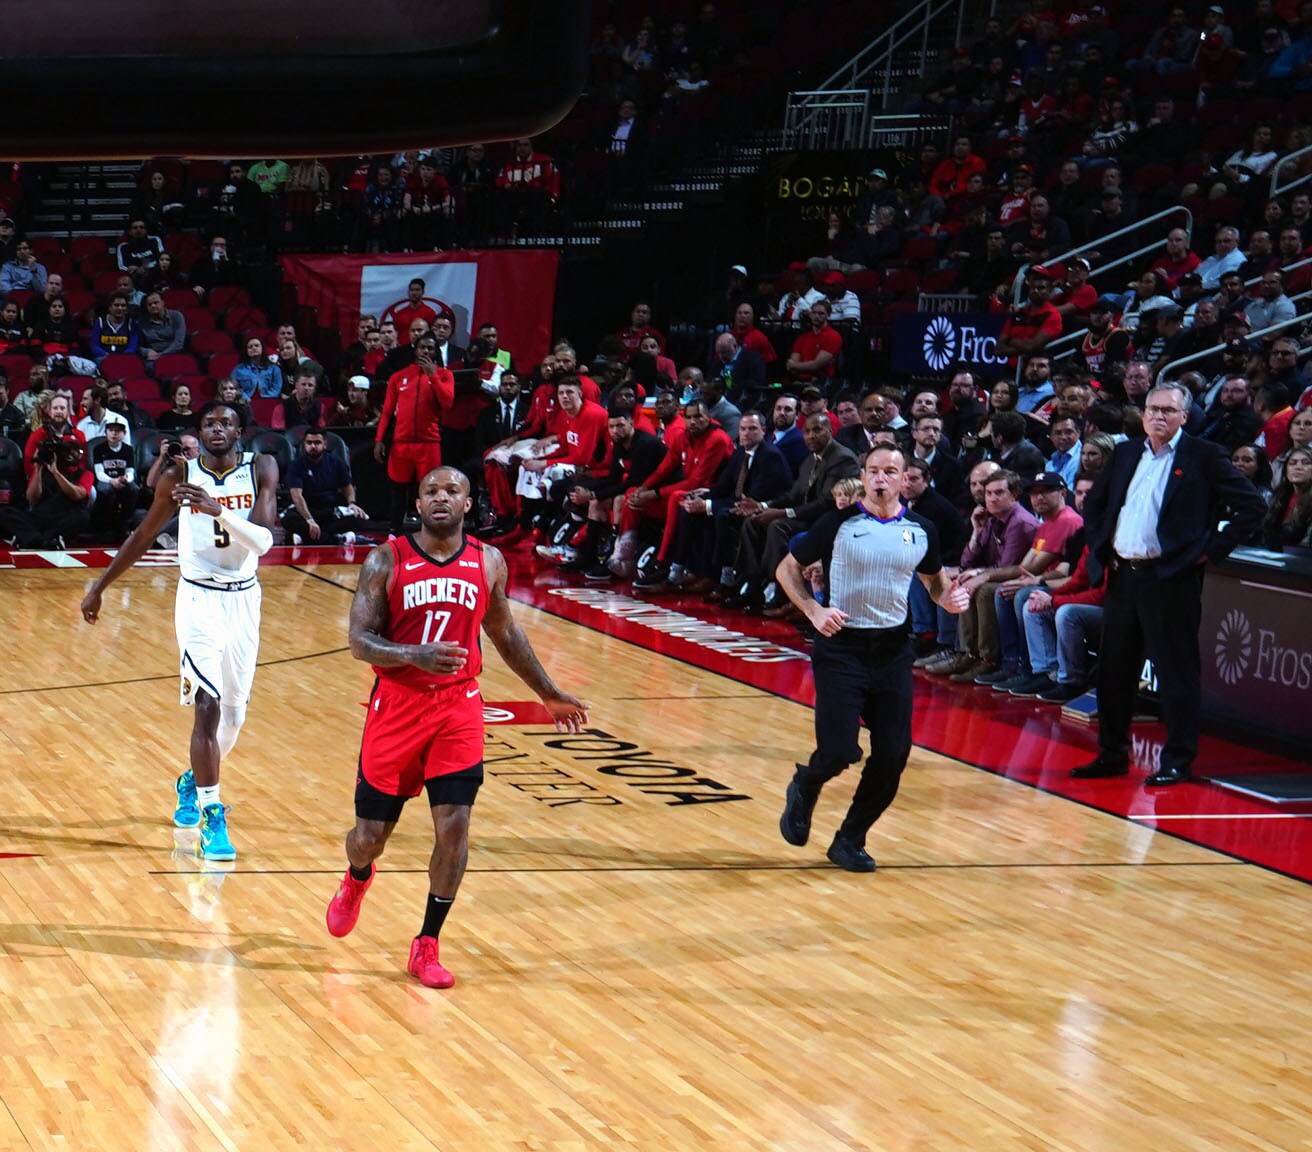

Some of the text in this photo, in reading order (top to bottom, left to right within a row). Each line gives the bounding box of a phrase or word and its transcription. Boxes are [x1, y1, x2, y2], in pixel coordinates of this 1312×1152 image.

[403, 577, 478, 611] ROCKETS
[421, 610, 451, 645] 17
[522, 728, 753, 806] TOYOTA
